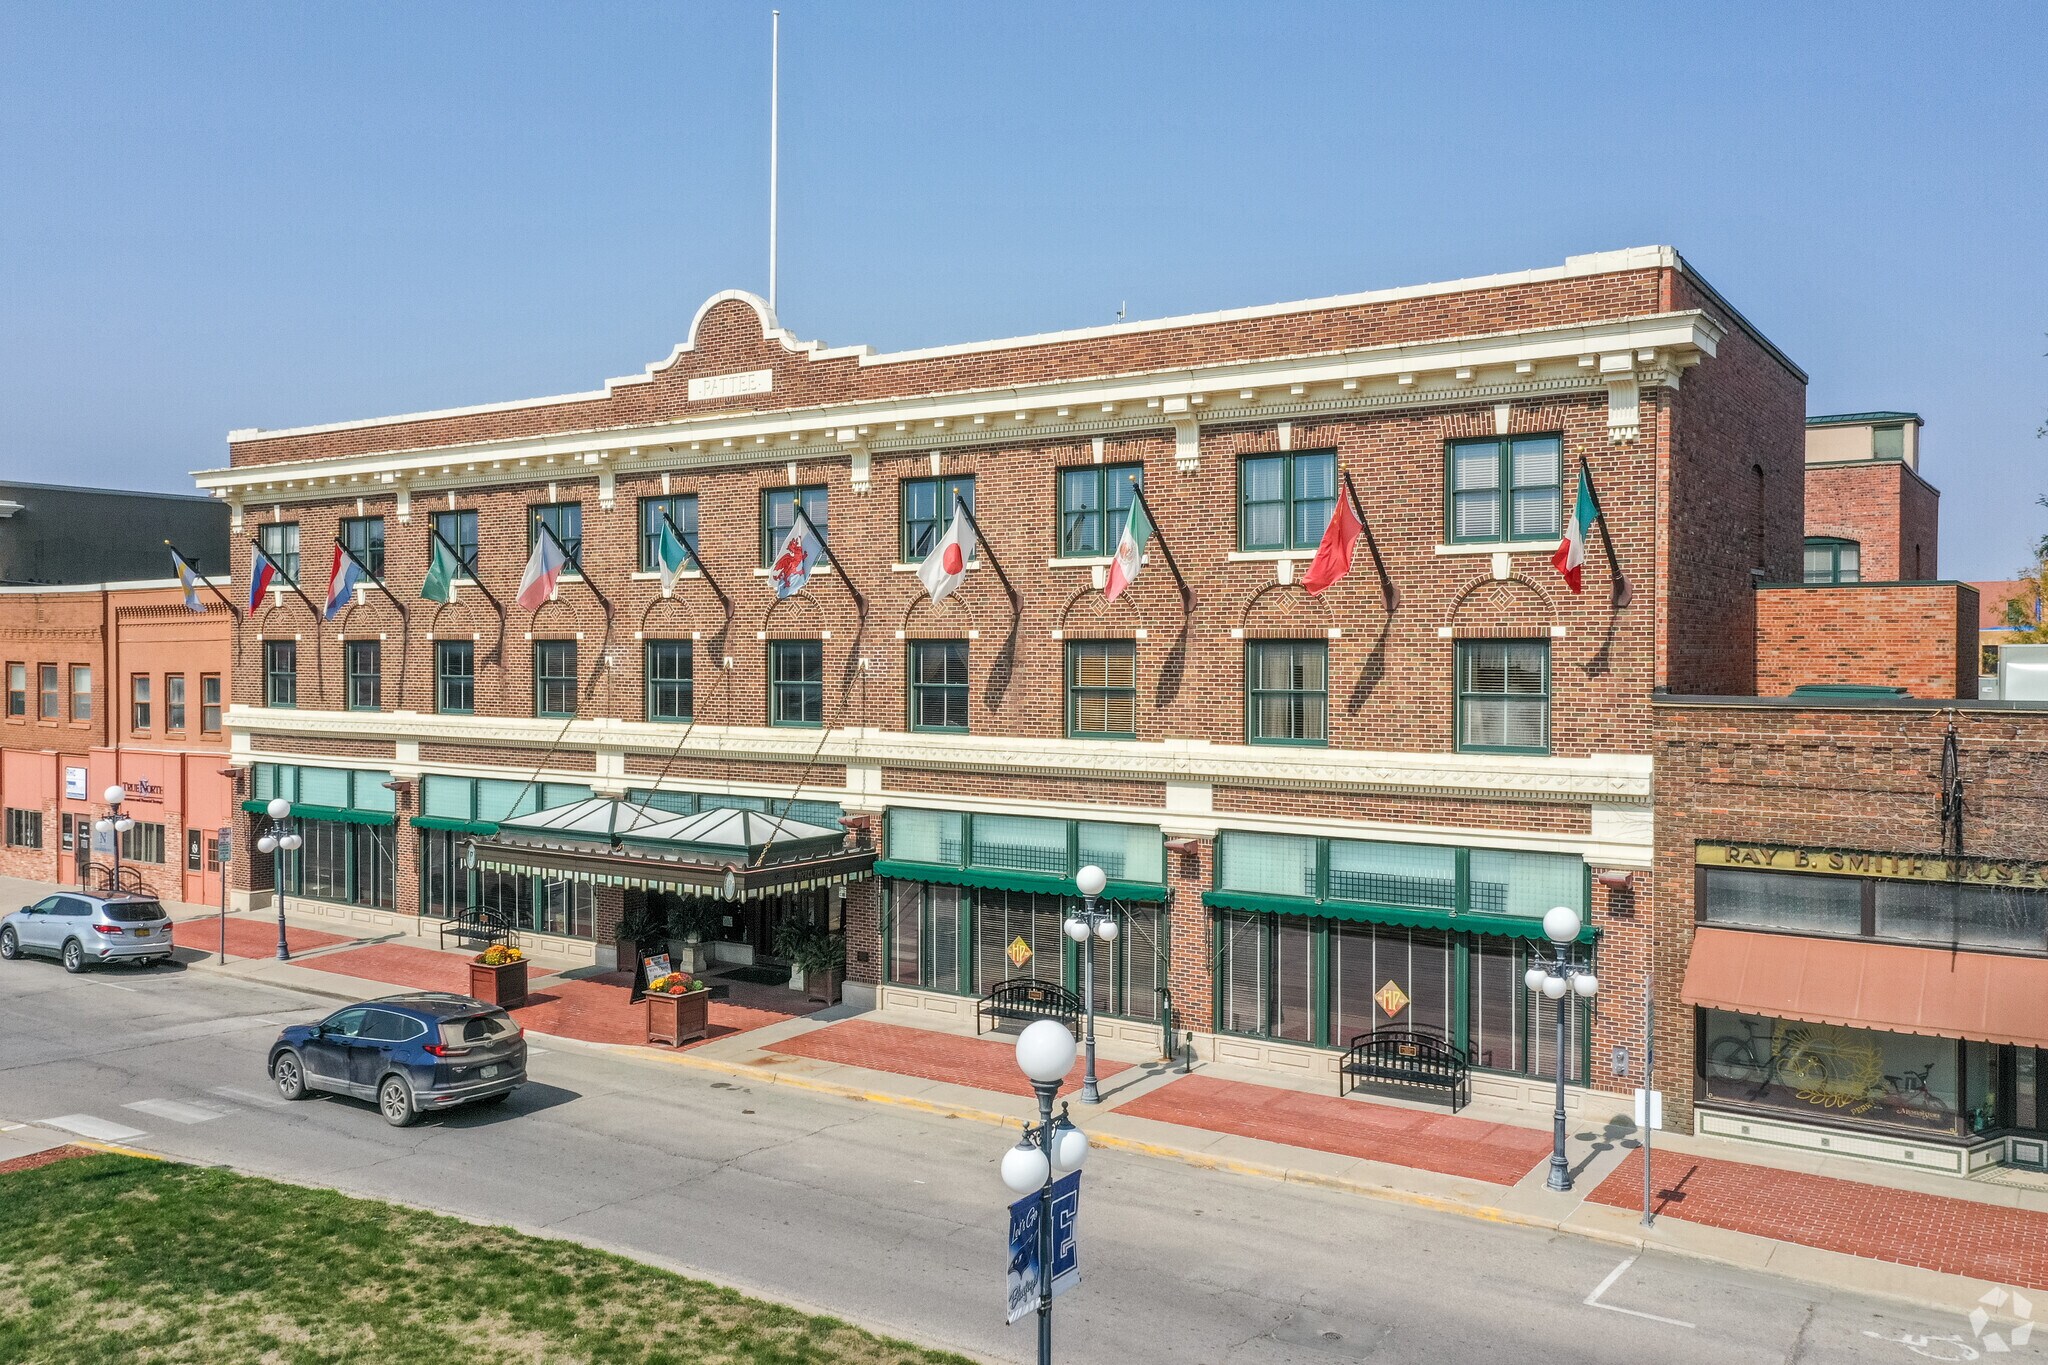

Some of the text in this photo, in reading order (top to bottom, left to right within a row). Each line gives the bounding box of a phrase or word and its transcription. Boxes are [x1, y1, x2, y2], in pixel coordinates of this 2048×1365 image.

[703, 374, 757, 396] PATTEE
[1724, 845, 1778, 866] RAY
[1794, 849, 1818, 869] B.
[1828, 851, 1924, 876] SMITH
[1383, 989, 1401, 1010] HP
[1011, 1206, 1039, 1245] Let's Go
[1051, 1189, 1078, 1282] E
